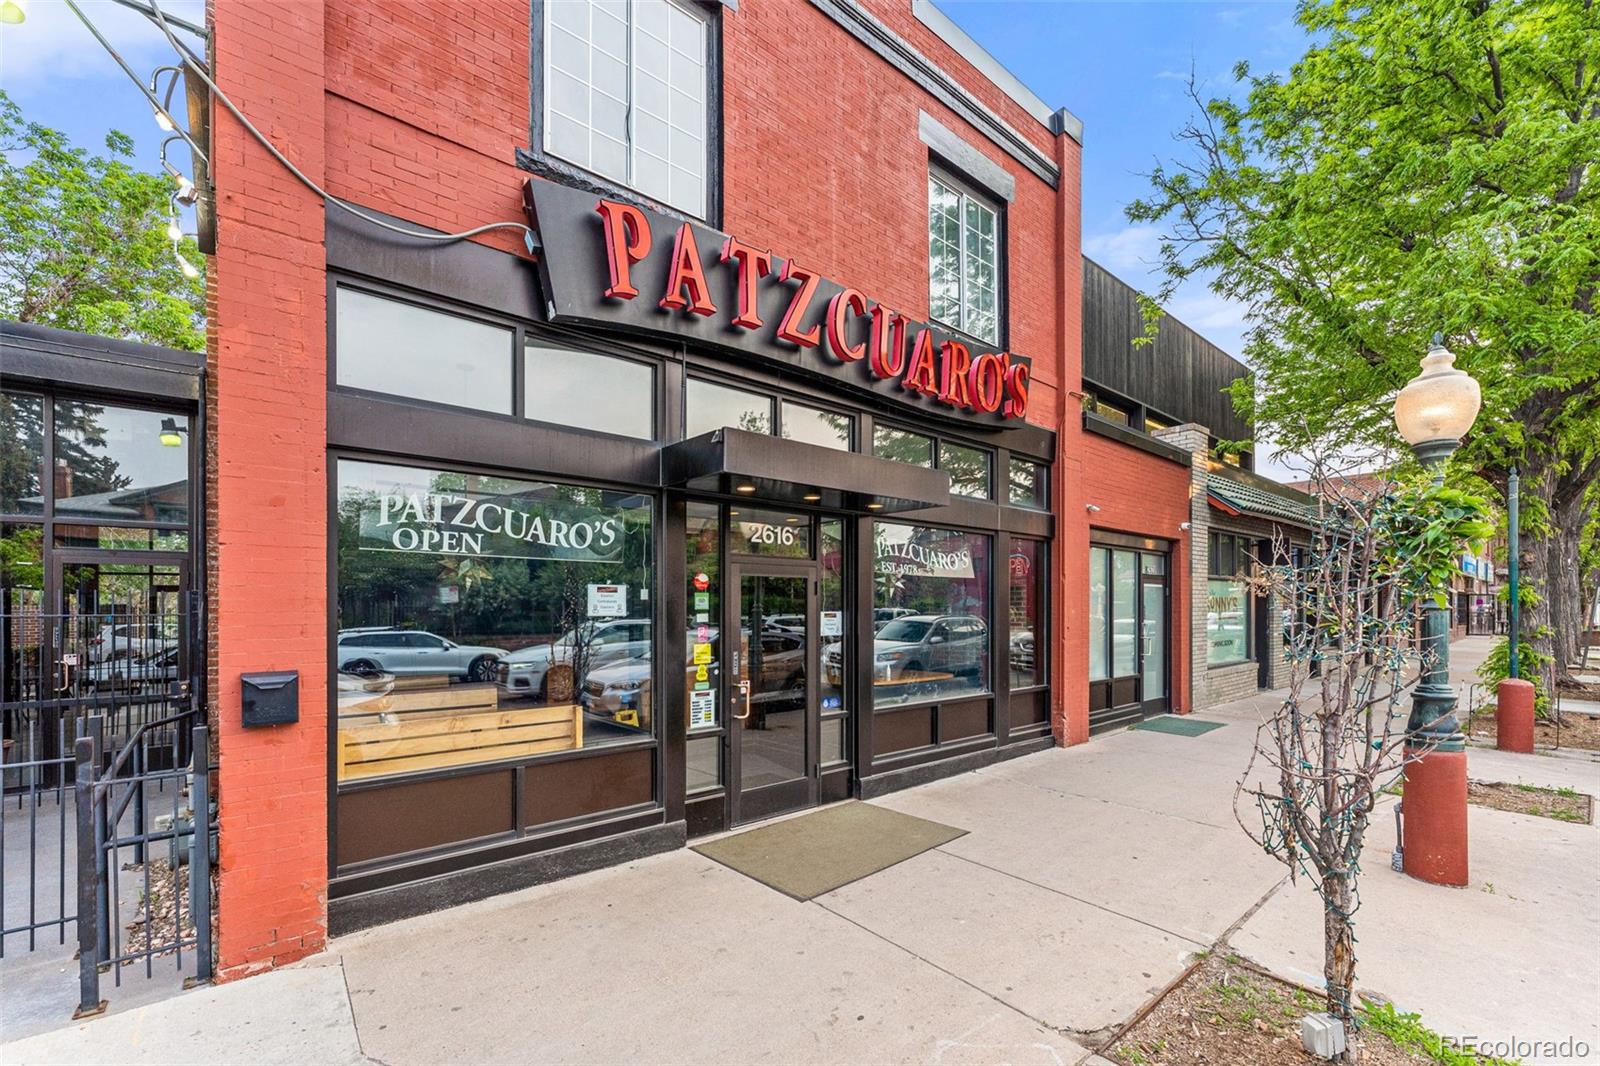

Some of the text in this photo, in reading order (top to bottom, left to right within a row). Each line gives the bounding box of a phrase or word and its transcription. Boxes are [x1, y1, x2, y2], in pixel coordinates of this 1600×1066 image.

[595, 199, 1028, 419] PATZCUARO'S
[376, 493, 616, 549] PATZCUARO'S
[751, 525, 794, 546] 2616
[392, 527, 485, 554] OPEN
[877, 537, 969, 570] PATZCUARO'S
